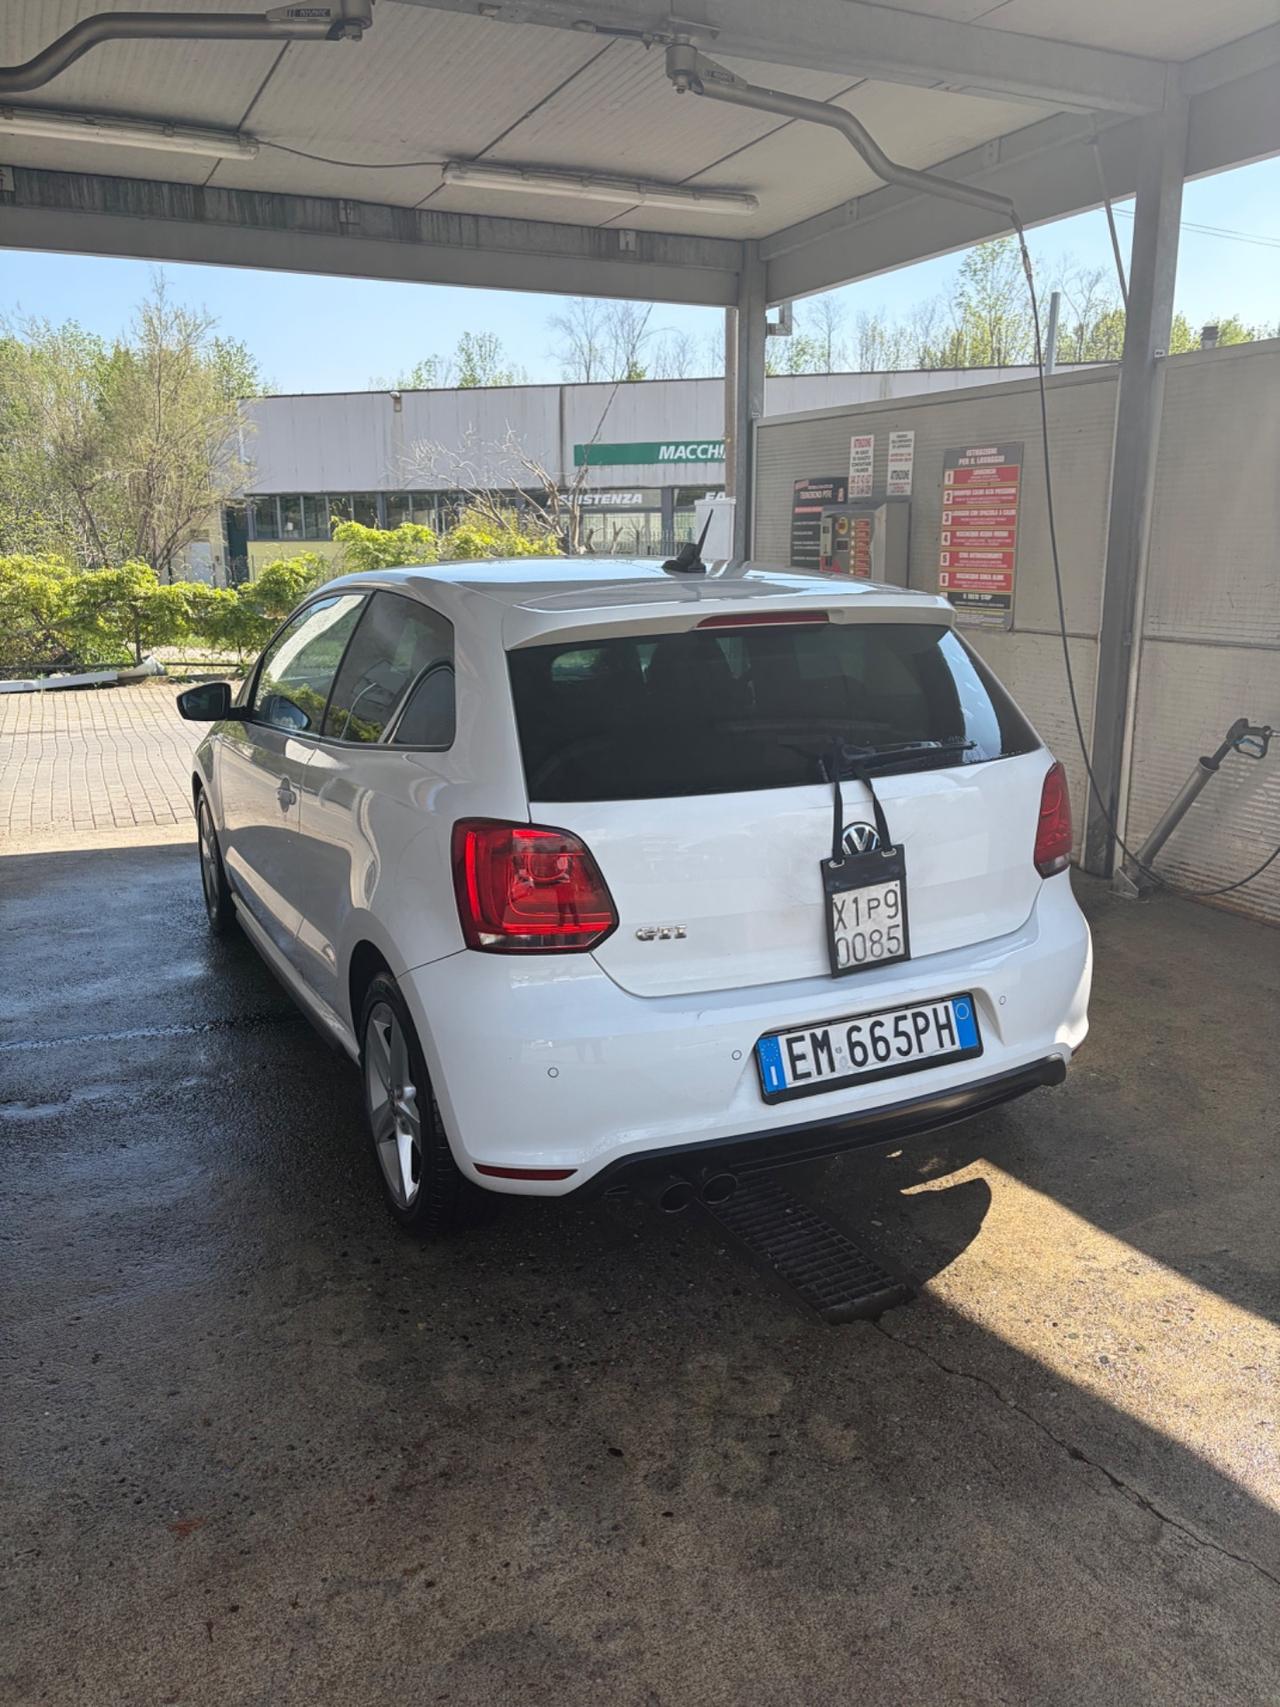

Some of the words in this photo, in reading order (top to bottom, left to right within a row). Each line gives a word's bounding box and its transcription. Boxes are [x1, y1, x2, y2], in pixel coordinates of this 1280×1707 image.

[658, 444, 726, 460] MACCHI
[833, 889, 899, 931] X1P9
[635, 923, 687, 941] GTI
[835, 924, 901, 966] 0085
[785, 1029, 836, 1081] EM
[846, 1004, 956, 1067] 665PH
